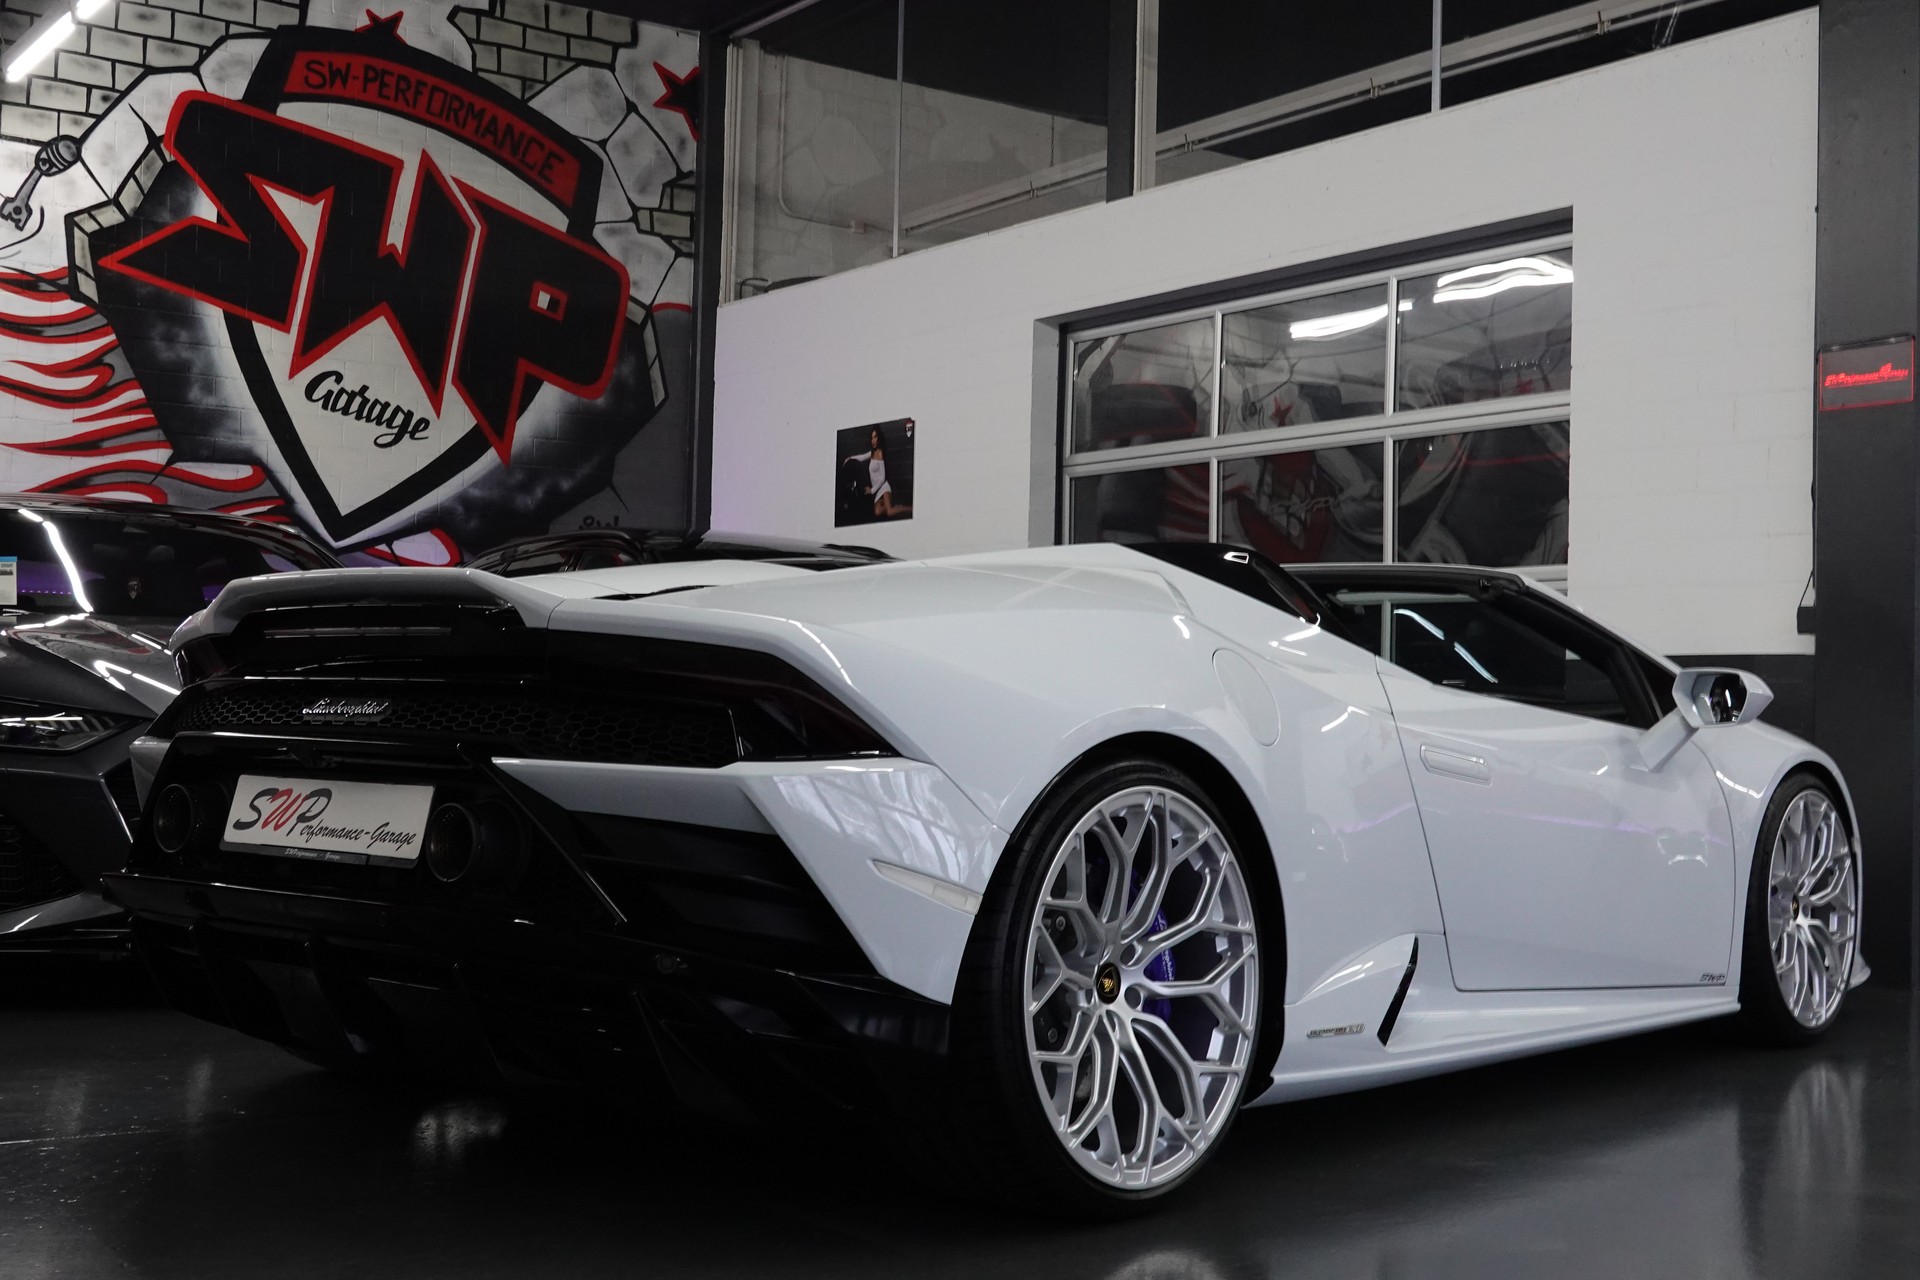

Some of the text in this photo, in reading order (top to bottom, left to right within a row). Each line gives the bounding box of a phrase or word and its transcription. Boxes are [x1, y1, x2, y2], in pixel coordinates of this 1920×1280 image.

[304, 58, 565, 186] SW-PERFORMANCE
[98, 90, 630, 467] SWP
[304, 371, 430, 447] Garage
